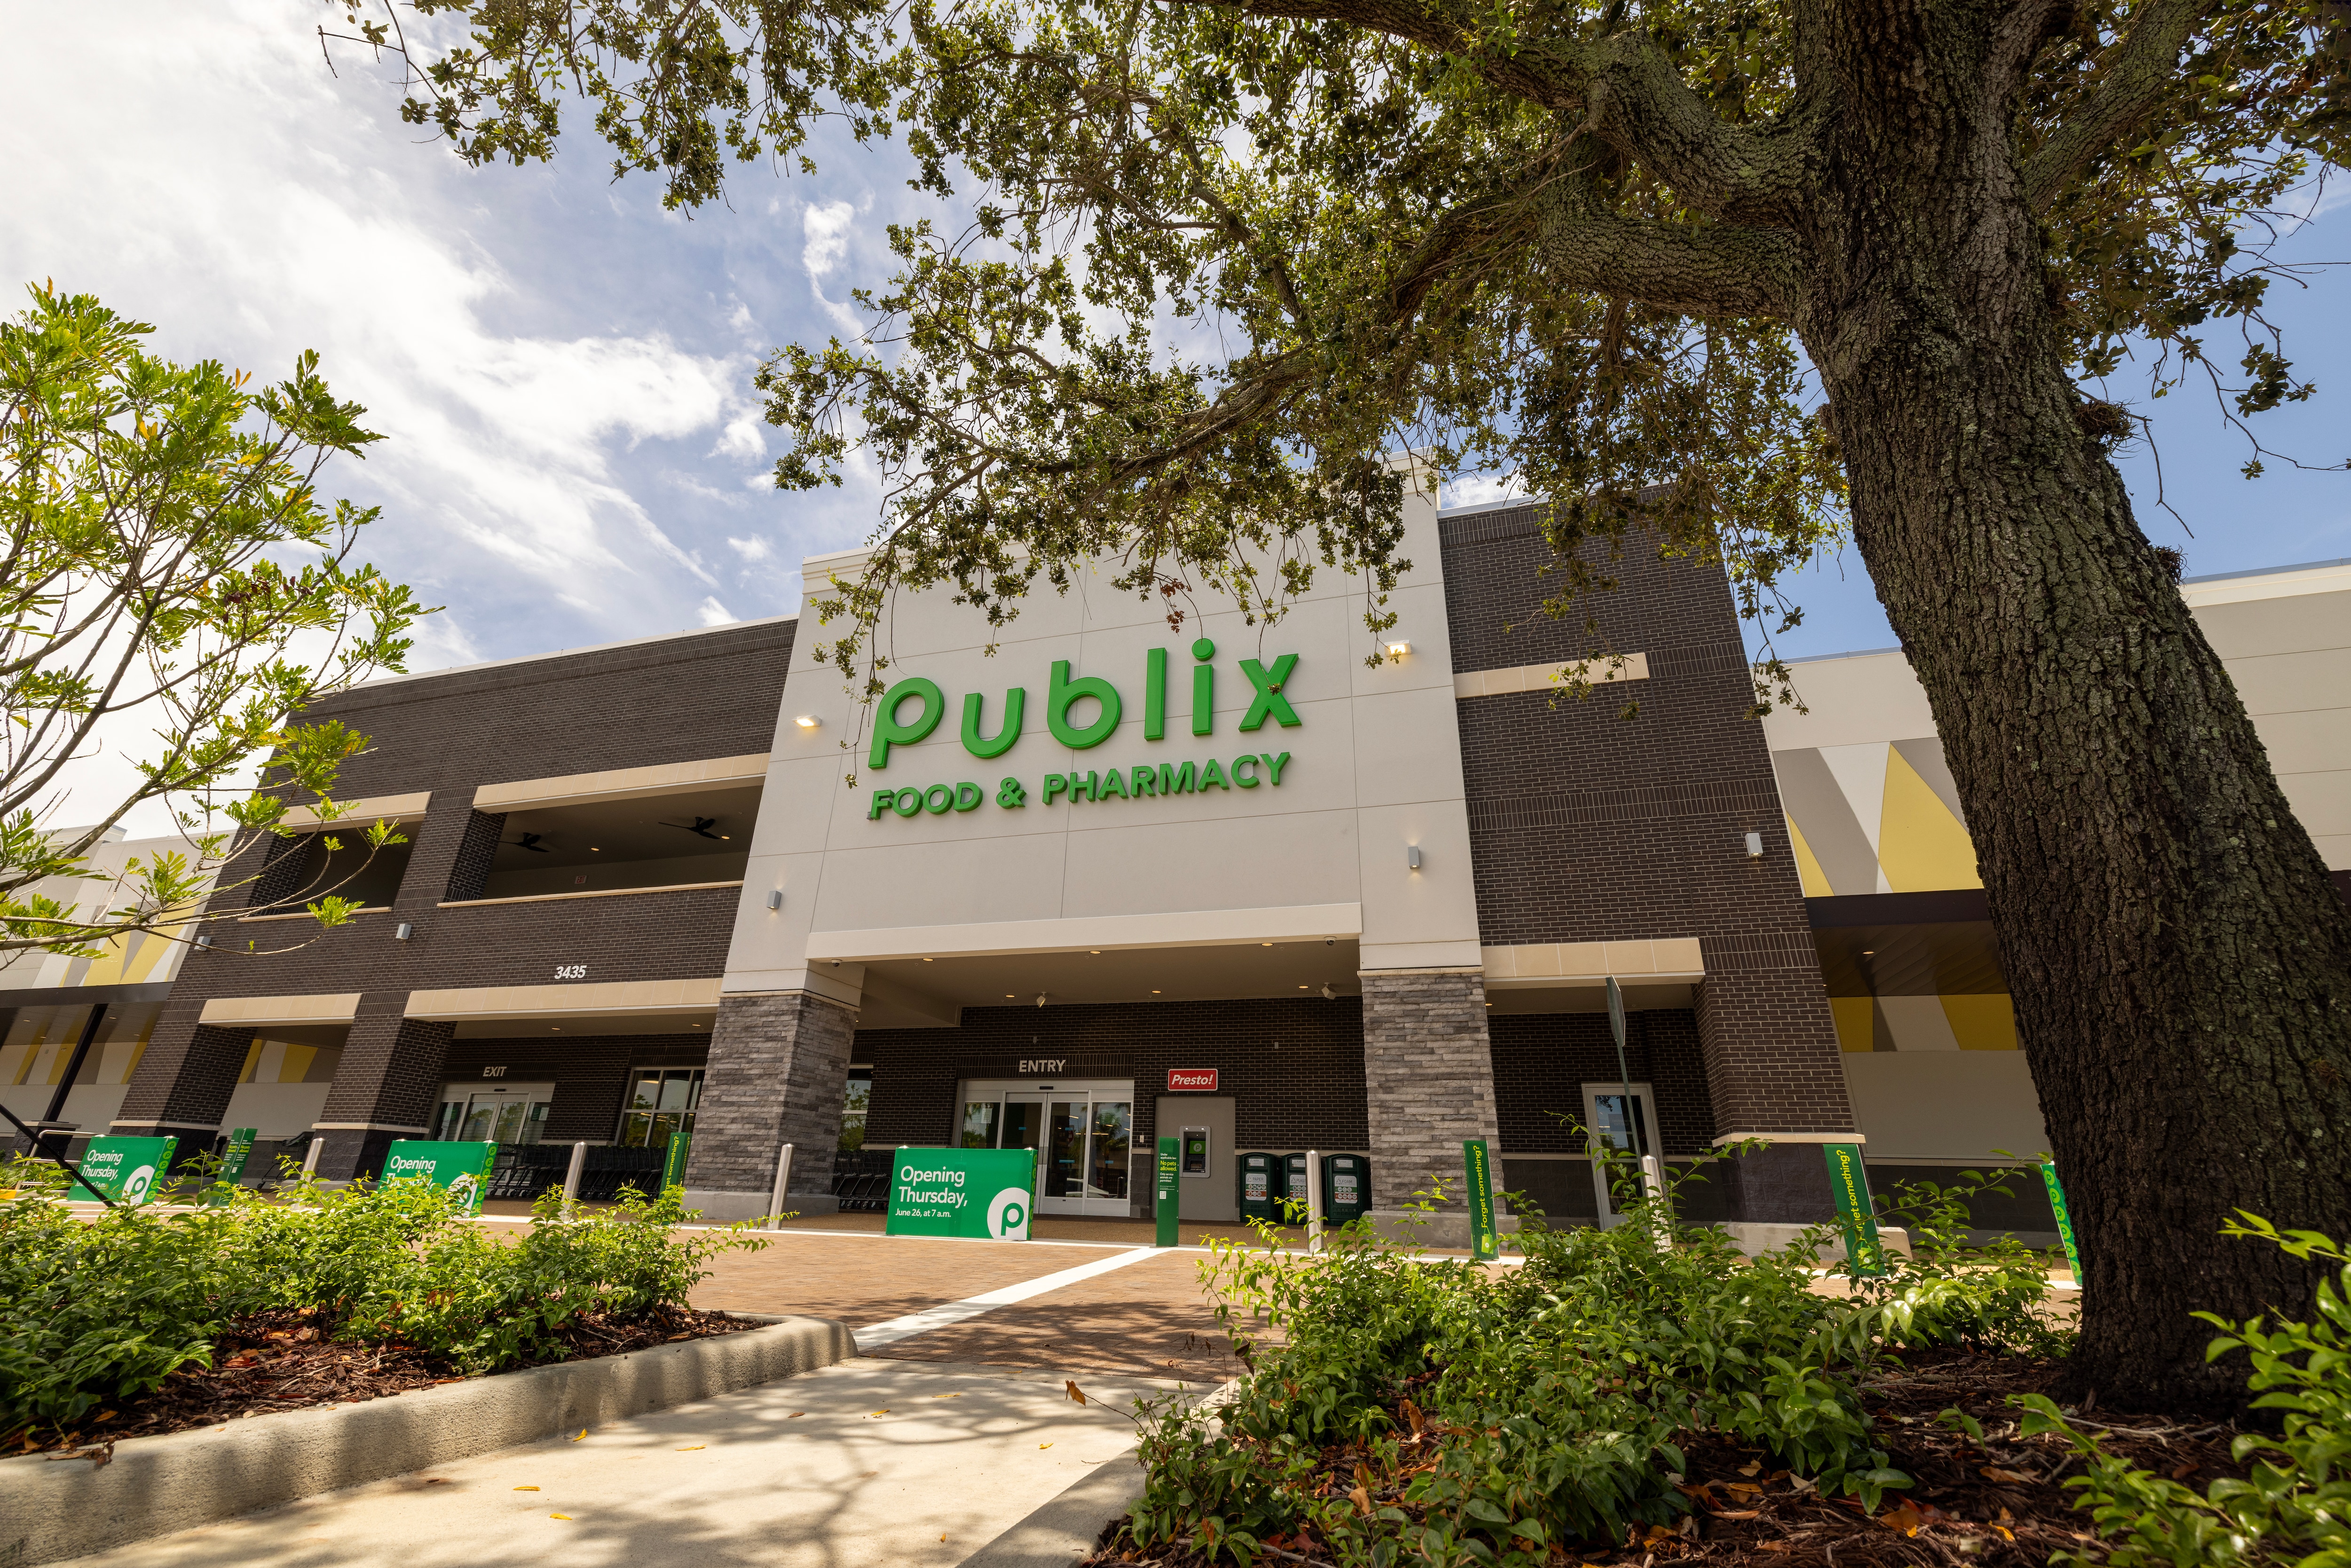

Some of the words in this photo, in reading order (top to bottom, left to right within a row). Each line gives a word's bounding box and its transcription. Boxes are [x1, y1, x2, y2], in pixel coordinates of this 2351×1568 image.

[868, 638, 1302, 769] Publix
[871, 782, 982, 819] FOOD
[996, 777, 1026, 809] &
[1042, 752, 1290, 805] PHARMACY
[554, 965, 587, 979] 3435
[483, 1066, 507, 1077] EXIT
[1019, 1060, 1066, 1072] ENTRY
[1171, 1074, 1213, 1085] Presto!
[87, 1150, 124, 1165] Opening
[390, 1155, 436, 1174] Opening
[668, 1136, 679, 1176] something?
[81, 1165, 118, 1181] Thursday,
[900, 1166, 965, 1187] Opening
[1473, 1145, 1485, 1197] something?
[1836, 1150, 1858, 1206] something?
[899, 1186, 968, 1208] Thursday,
[912, 1209, 922, 1218] 26,
[1479, 1198, 1488, 1228] Forget
[1851, 1207, 1866, 1241] Fret
